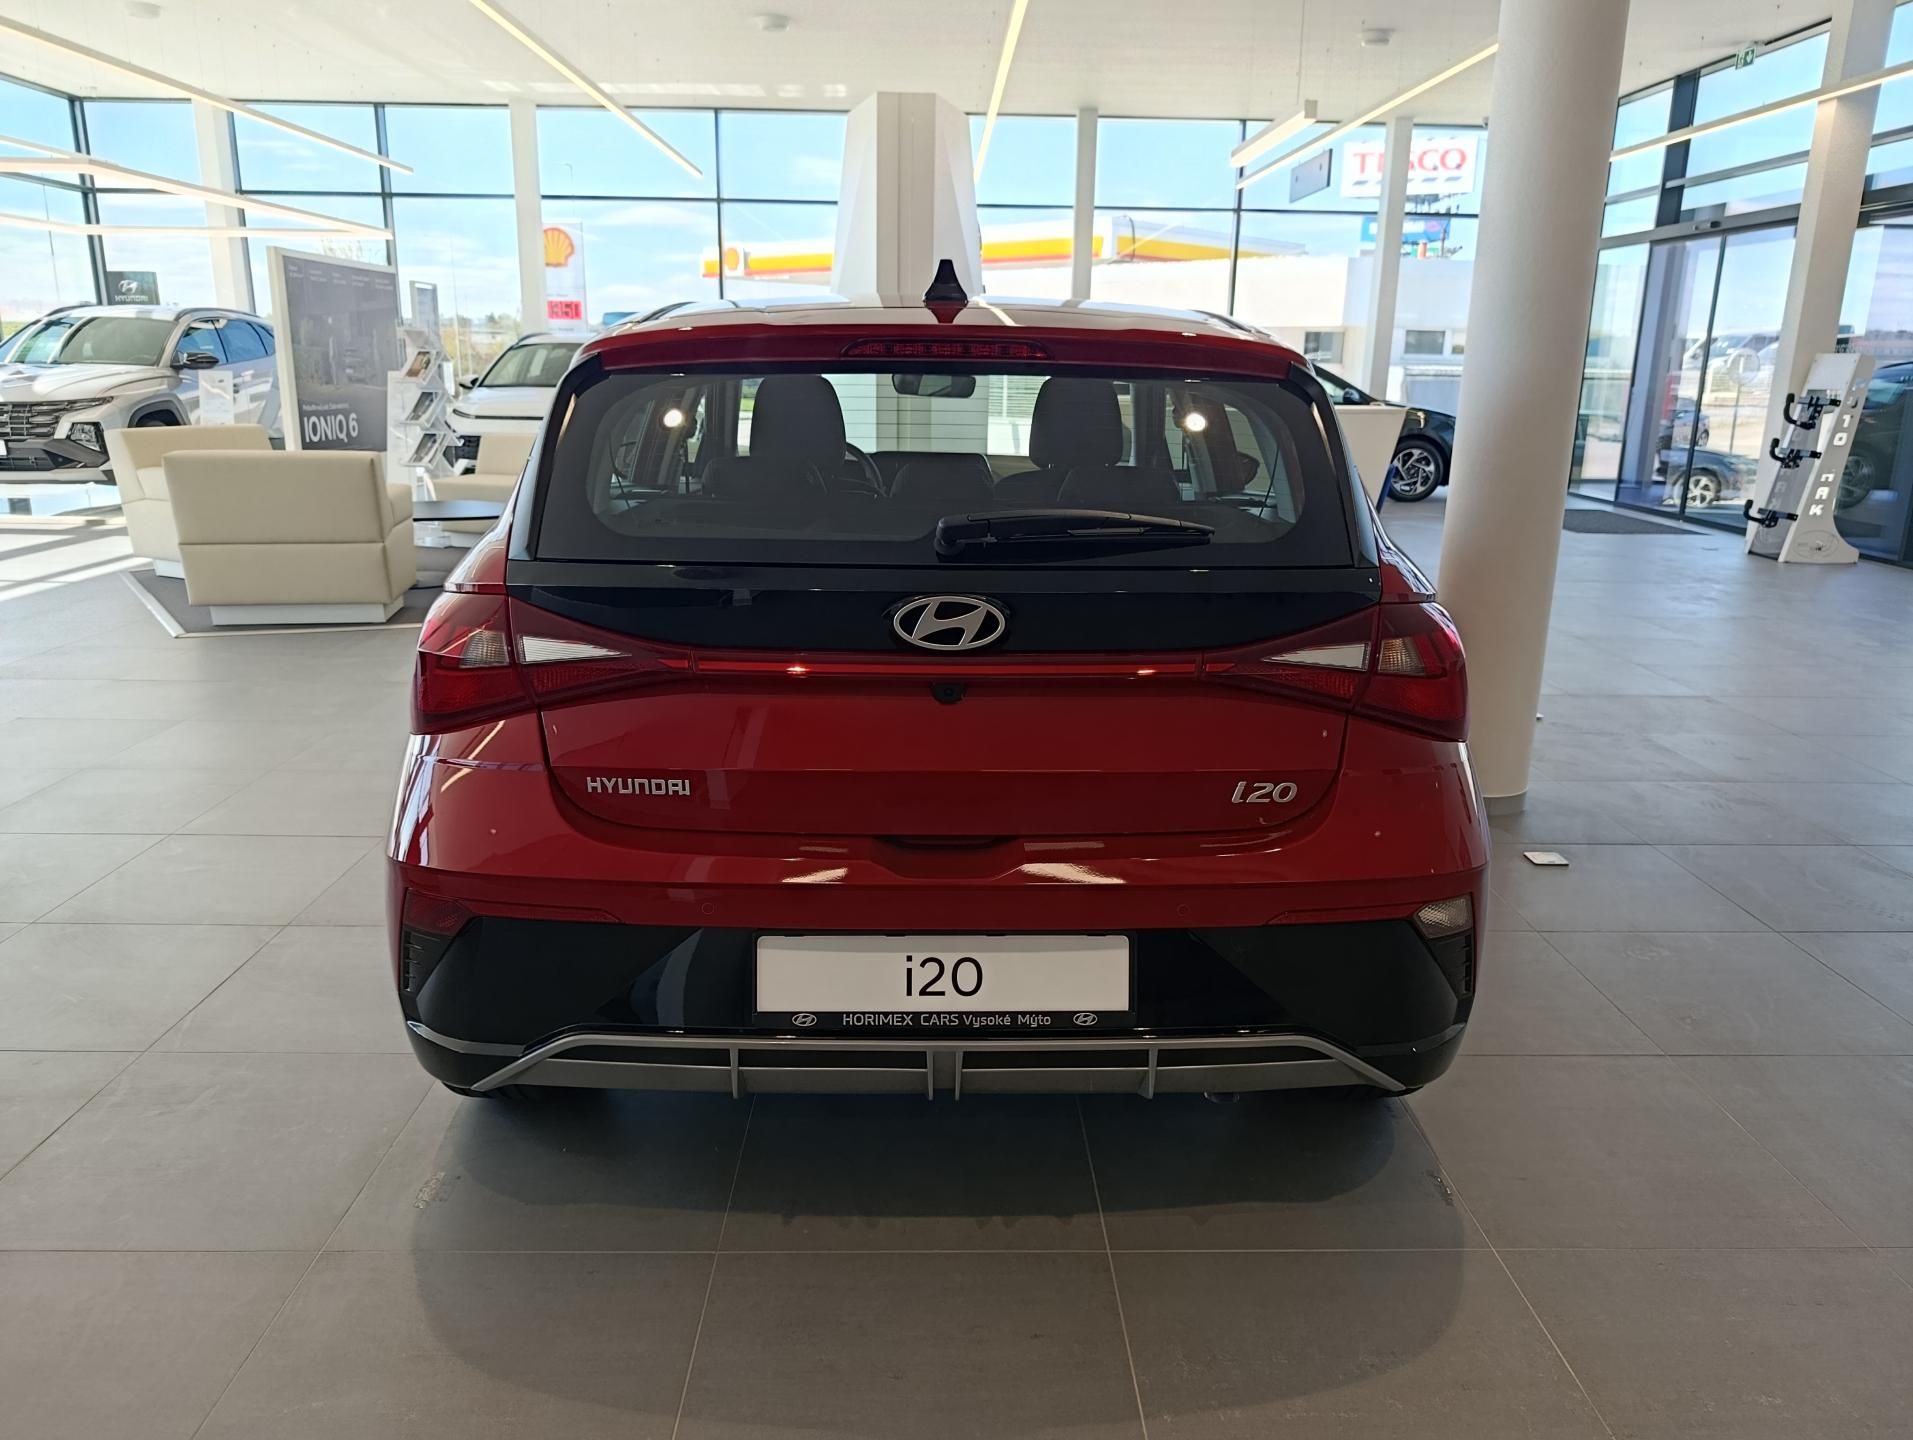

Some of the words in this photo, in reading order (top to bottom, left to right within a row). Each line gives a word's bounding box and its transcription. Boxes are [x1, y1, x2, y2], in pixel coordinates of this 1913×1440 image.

[1353, 148, 1467, 174] TCO
[303, 414, 348, 443] IONIQ
[349, 412, 359, 438] 6
[586, 776, 691, 796] HYUNDAI
[1231, 781, 1298, 804] i20
[905, 955, 984, 998] i20
[843, 1013, 913, 1026] HORIMEX
[920, 1013, 959, 1026] CARS
[963, 1013, 1011, 1028] Vysoké
[1017, 1013, 1051, 1028] Mýto
